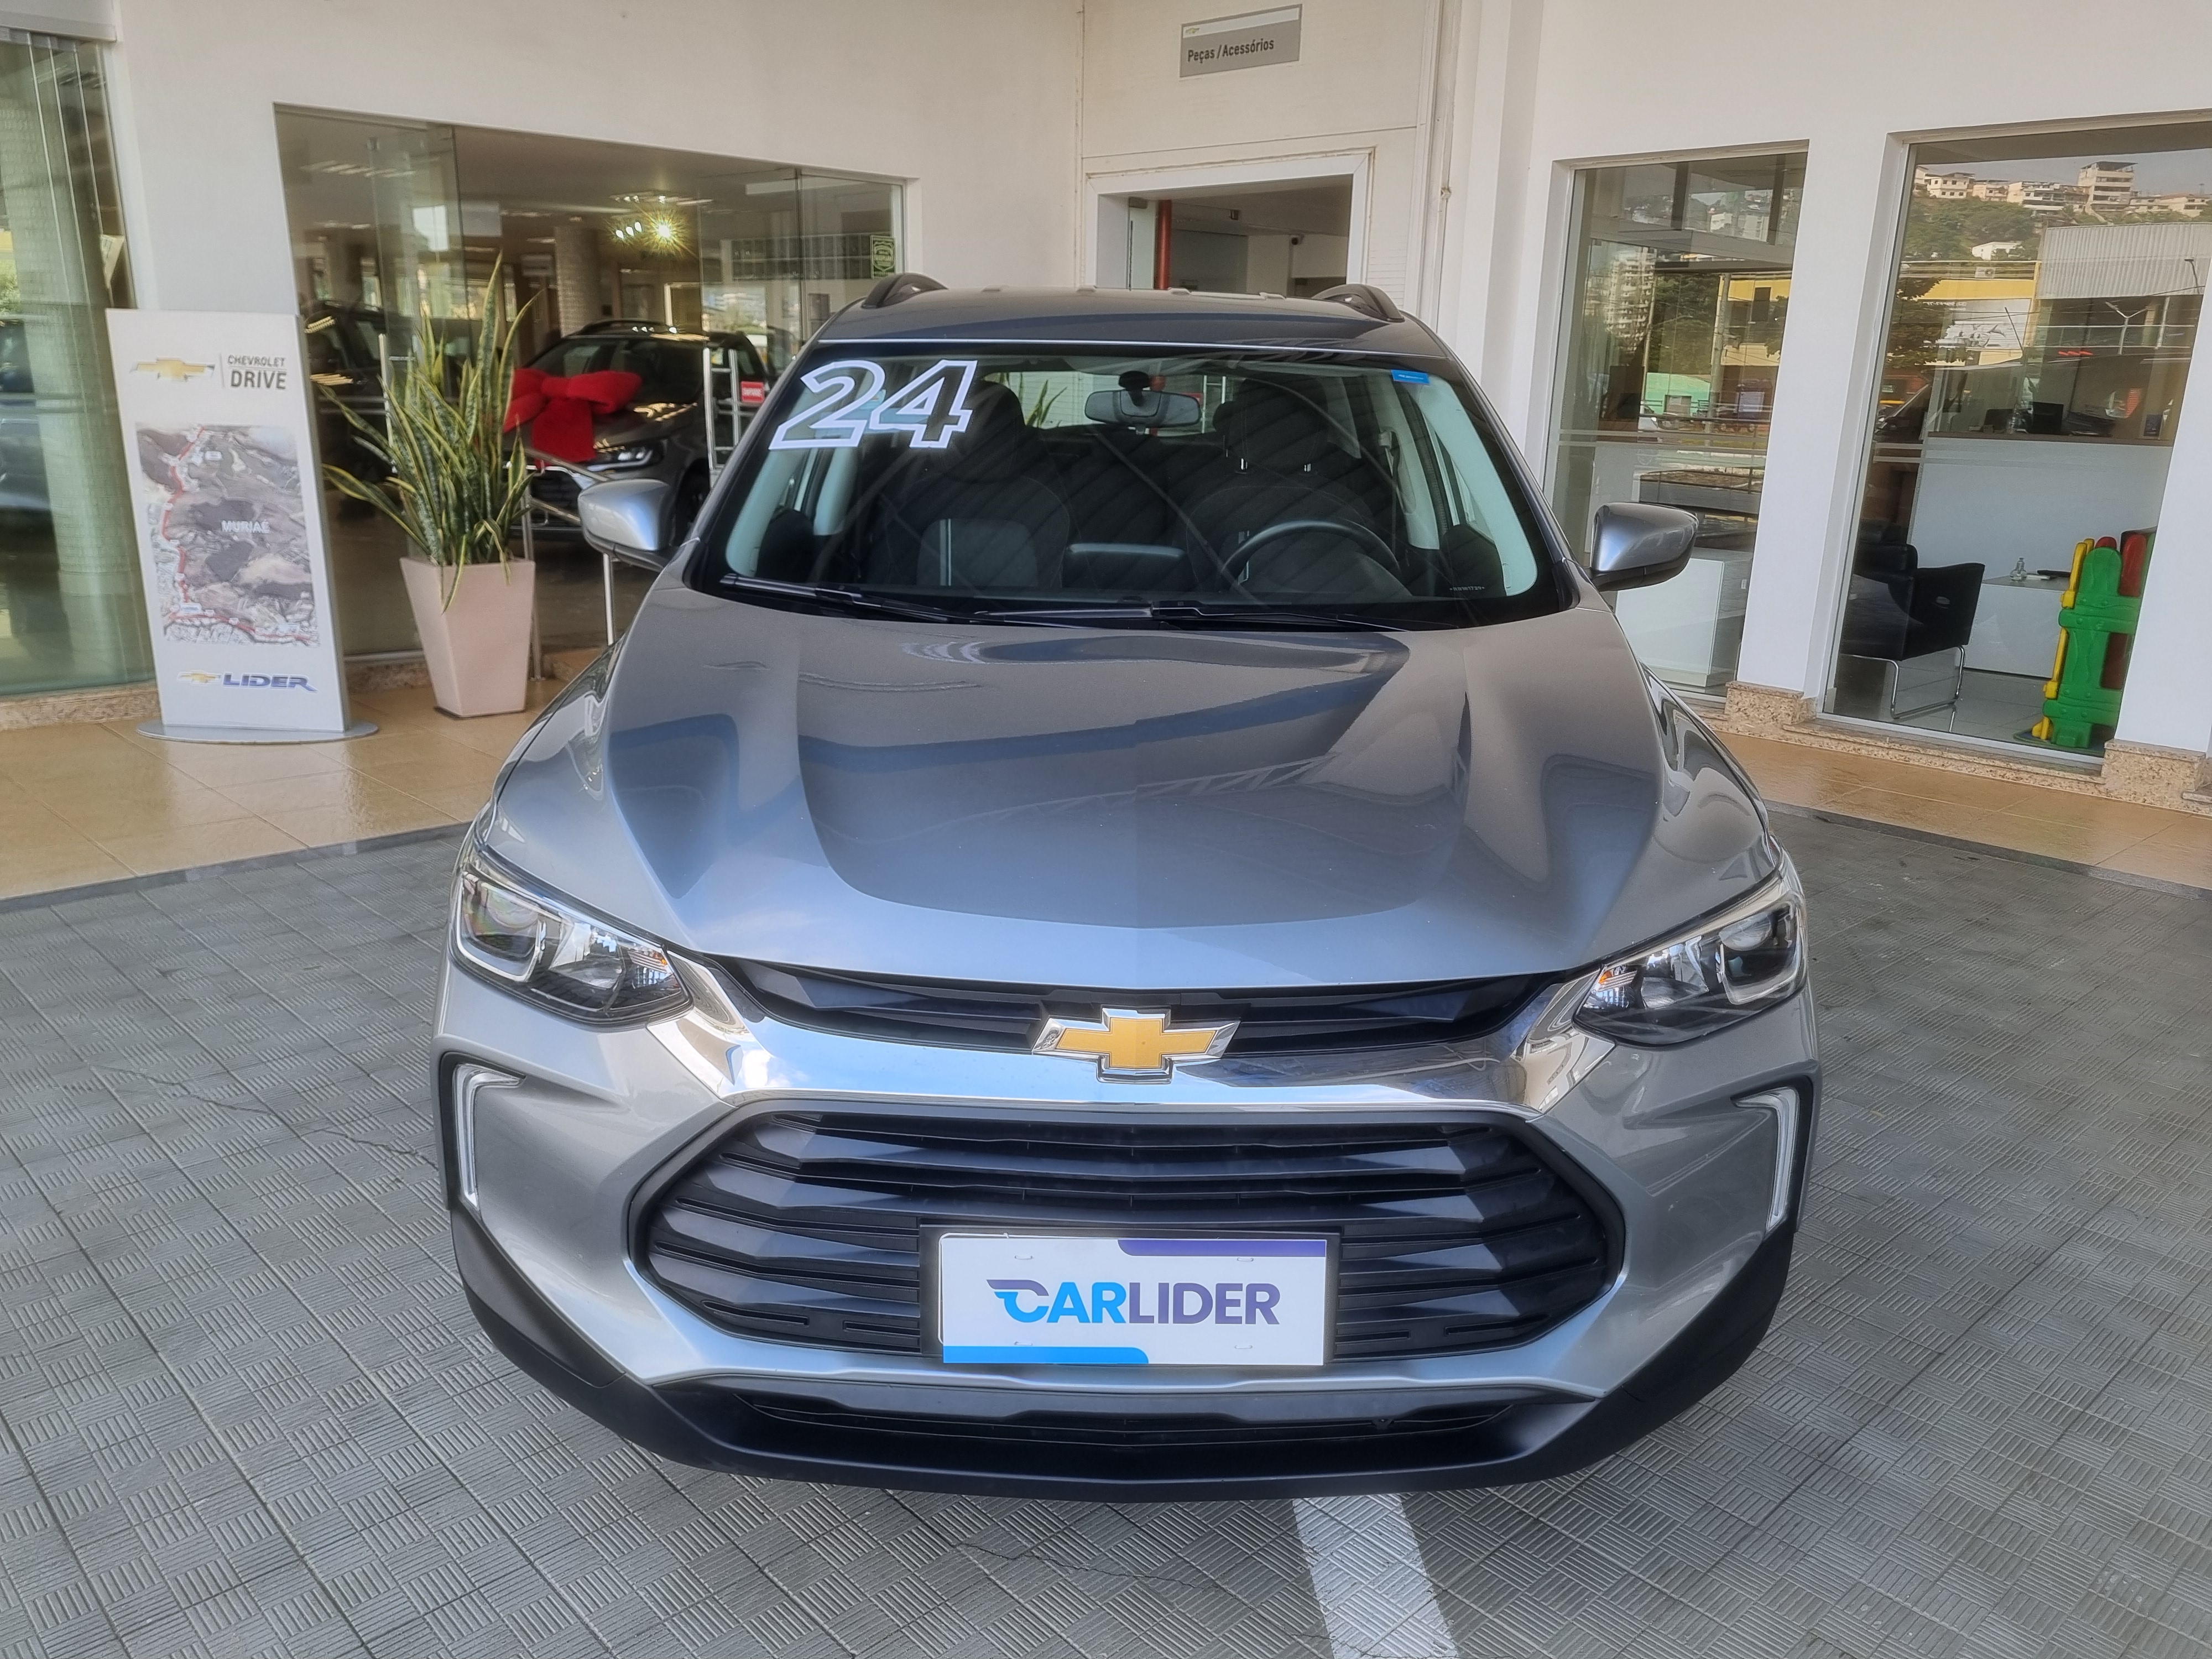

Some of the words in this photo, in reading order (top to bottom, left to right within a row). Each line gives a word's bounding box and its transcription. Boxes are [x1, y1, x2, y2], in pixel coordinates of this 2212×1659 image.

[228, 354, 286, 367] CHEVROLET
[231, 369, 287, 389] DRIVE
[769, 359, 978, 450] 24
[222, 672, 319, 692] LIDER
[986, 1279, 1280, 1324] CARLIDER
